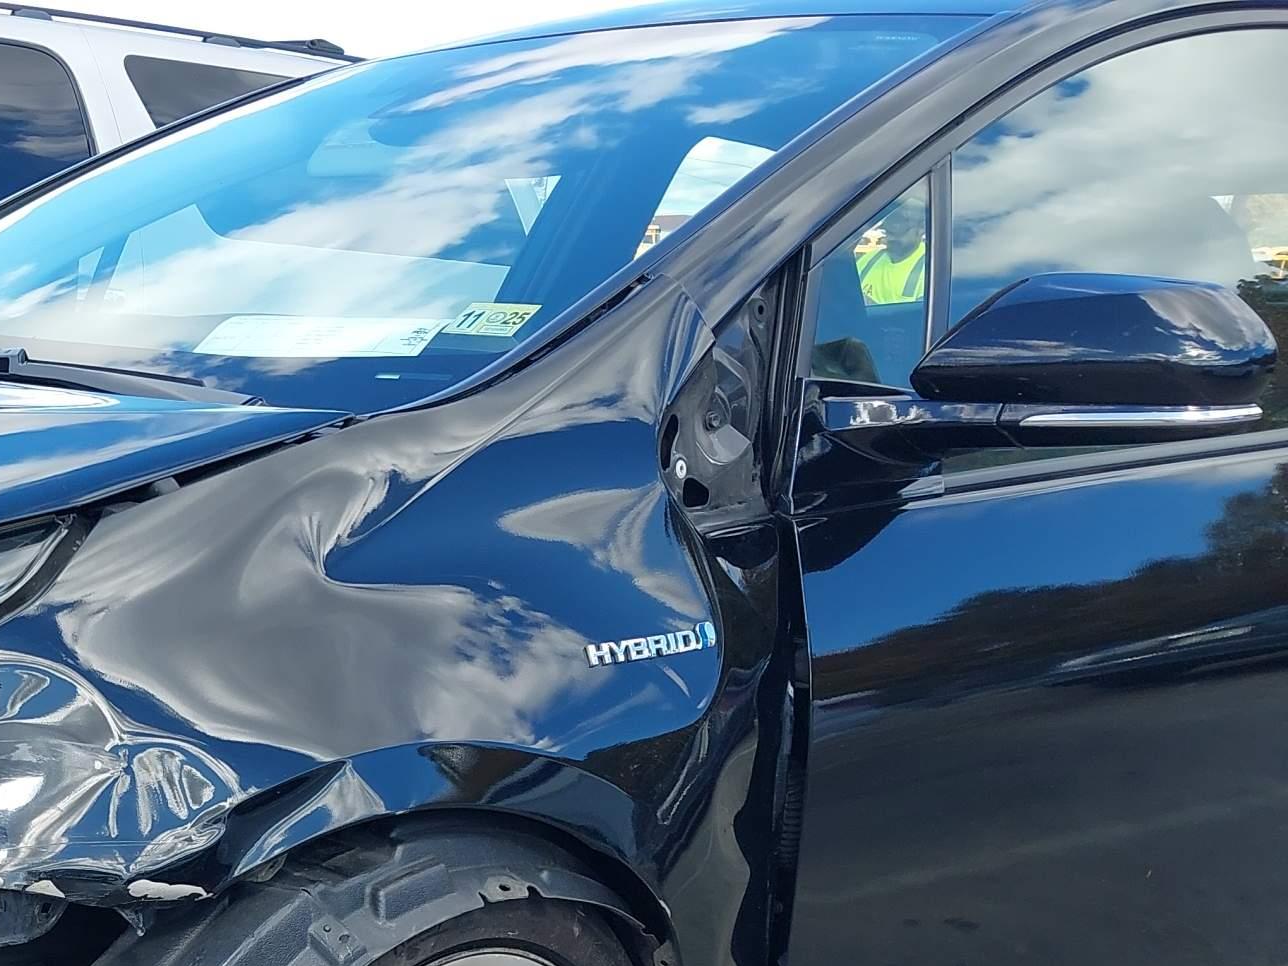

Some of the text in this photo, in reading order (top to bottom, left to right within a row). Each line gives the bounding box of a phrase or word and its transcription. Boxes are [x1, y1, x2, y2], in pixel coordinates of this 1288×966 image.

[456, 310, 531, 329] 11 25
[584, 630, 702, 668] HYBRID
